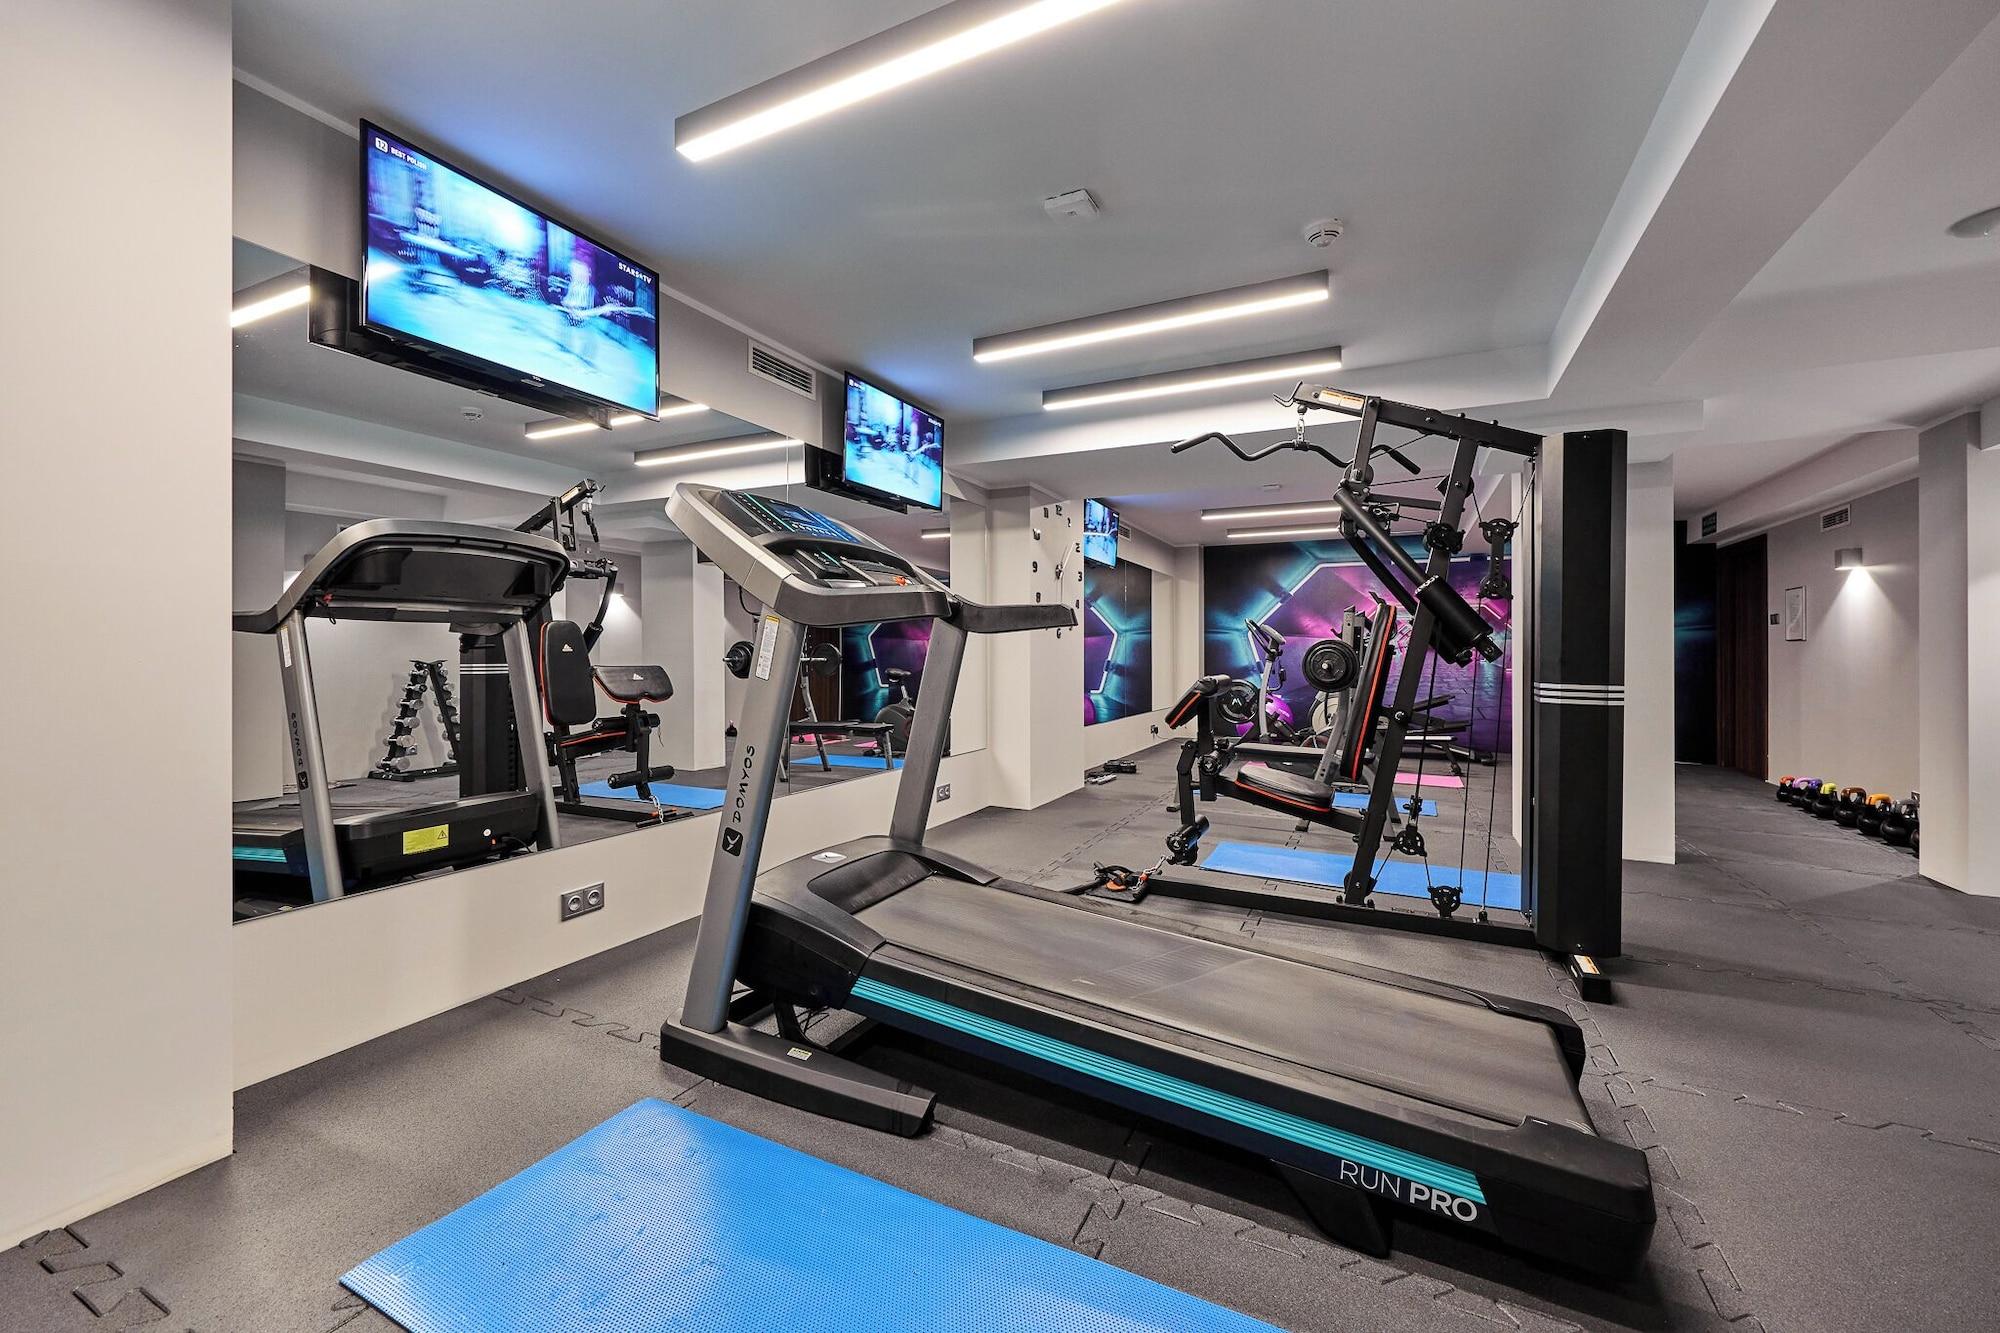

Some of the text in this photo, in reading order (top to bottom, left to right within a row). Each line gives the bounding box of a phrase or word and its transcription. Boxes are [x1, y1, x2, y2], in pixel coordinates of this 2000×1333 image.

[390, 146, 406, 160] BEST
[1043, 507, 1049, 519] 11
[1075, 542, 1081, 553] 2
[1032, 560, 1038, 573] 9
[1077, 571, 1083, 582] 3
[1035, 592, 1041, 603] 8
[1075, 599, 1080, 609] 4
[1056, 628, 1062, 639] 6
[732, 745, 756, 824] DOMYOS
[1340, 1159, 1478, 1222] RUN PRO
